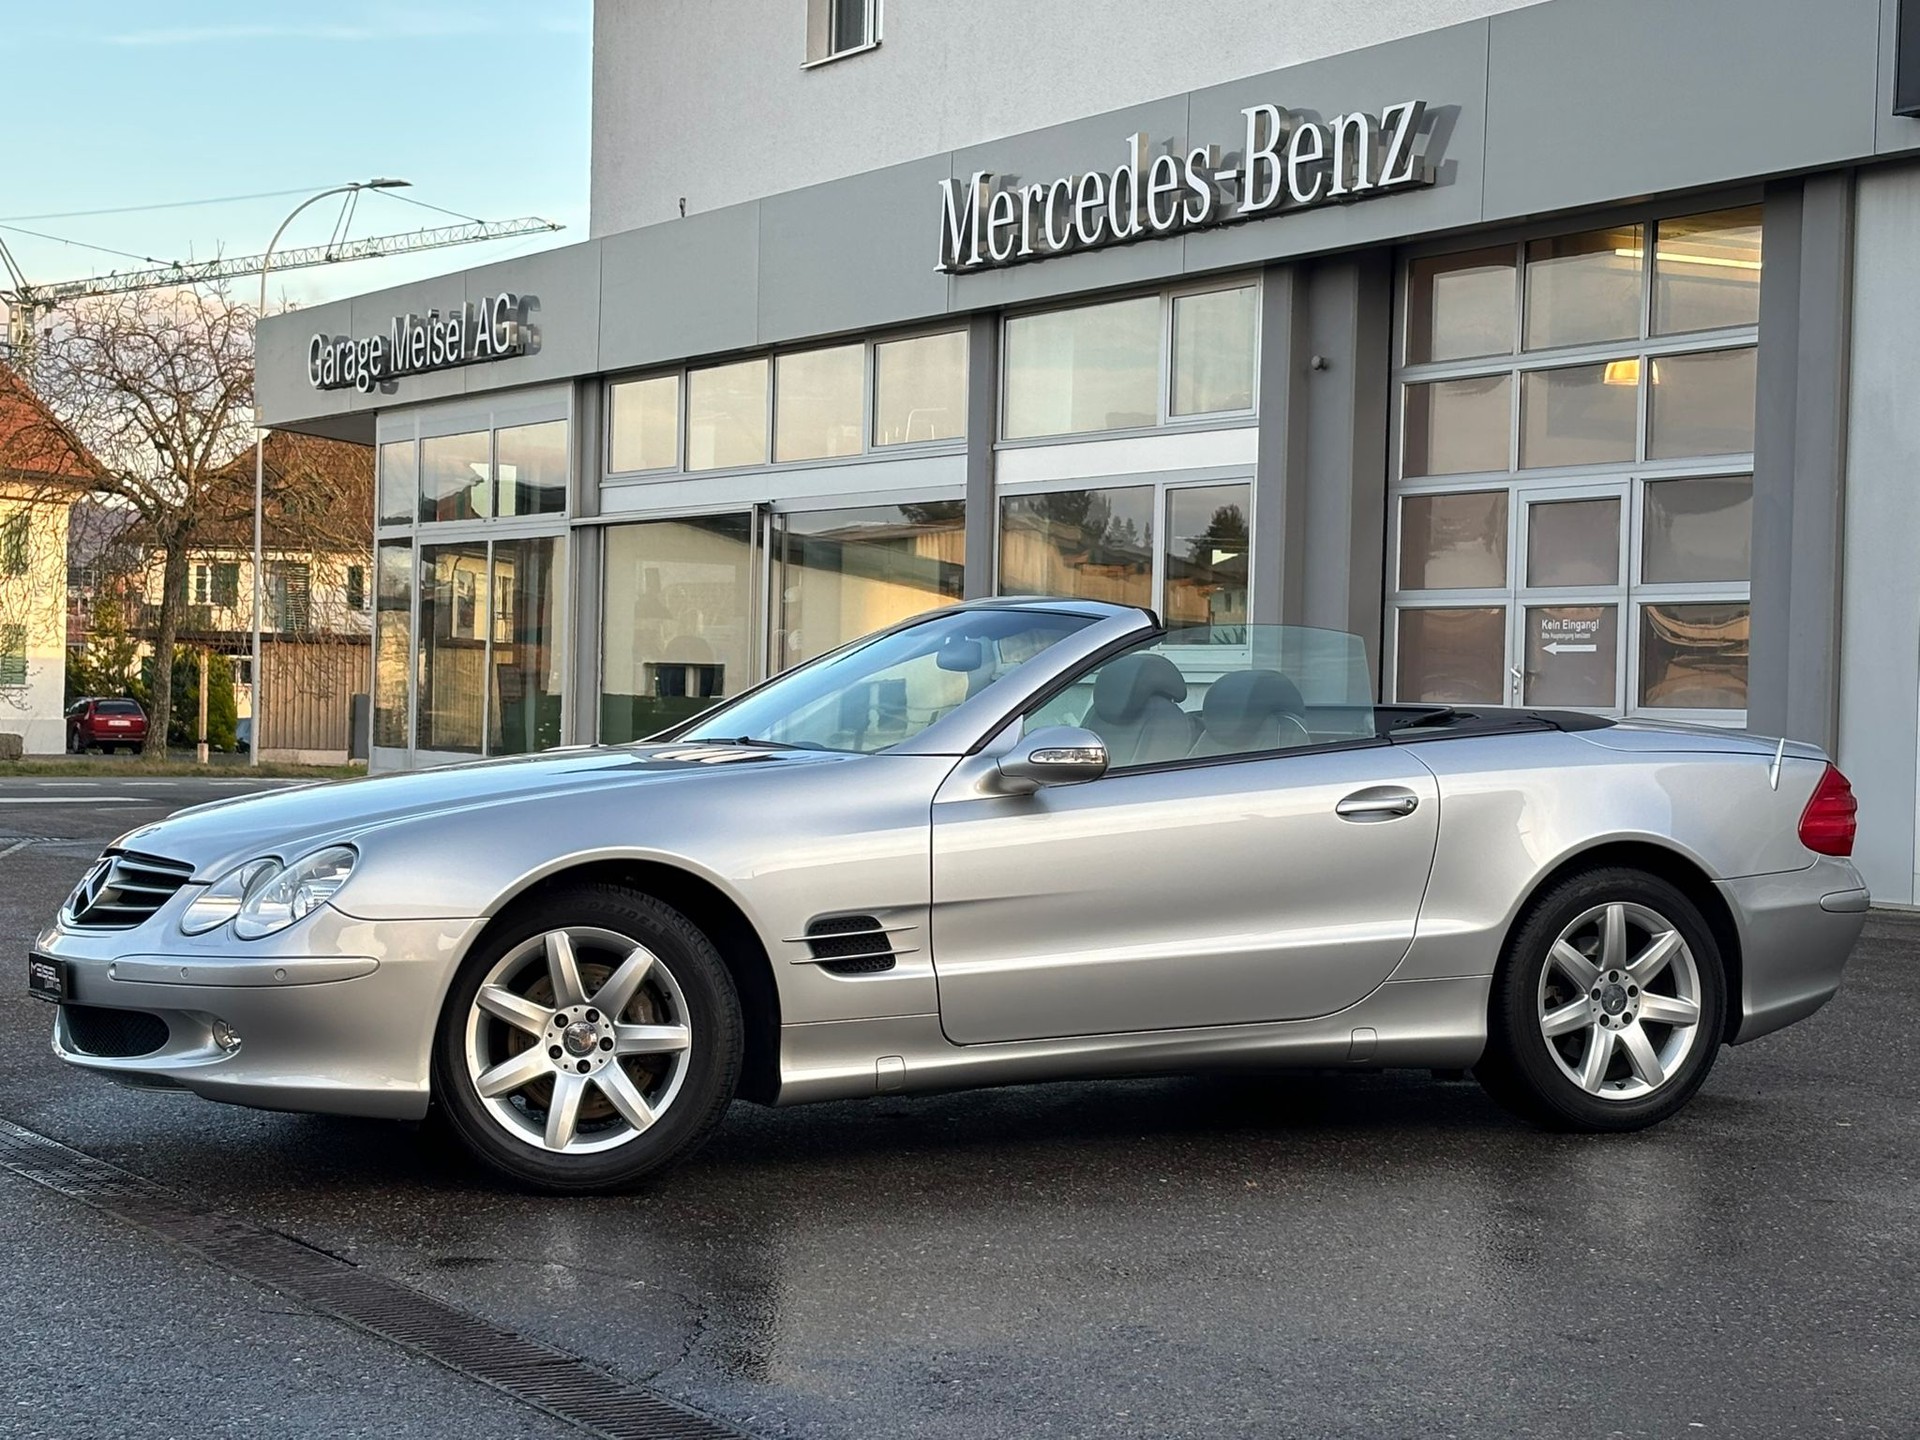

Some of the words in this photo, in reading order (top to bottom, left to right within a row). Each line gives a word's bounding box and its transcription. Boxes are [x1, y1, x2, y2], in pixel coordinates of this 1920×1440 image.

[934, 100, 1428, 272] Mercedes-Benz
[308, 333, 383, 393] Garage
[390, 301, 468, 372] Meisel
[474, 292, 514, 356] AG
[1541, 619, 1560, 630] Kein
[1562, 619, 1600, 632] Eingang!
